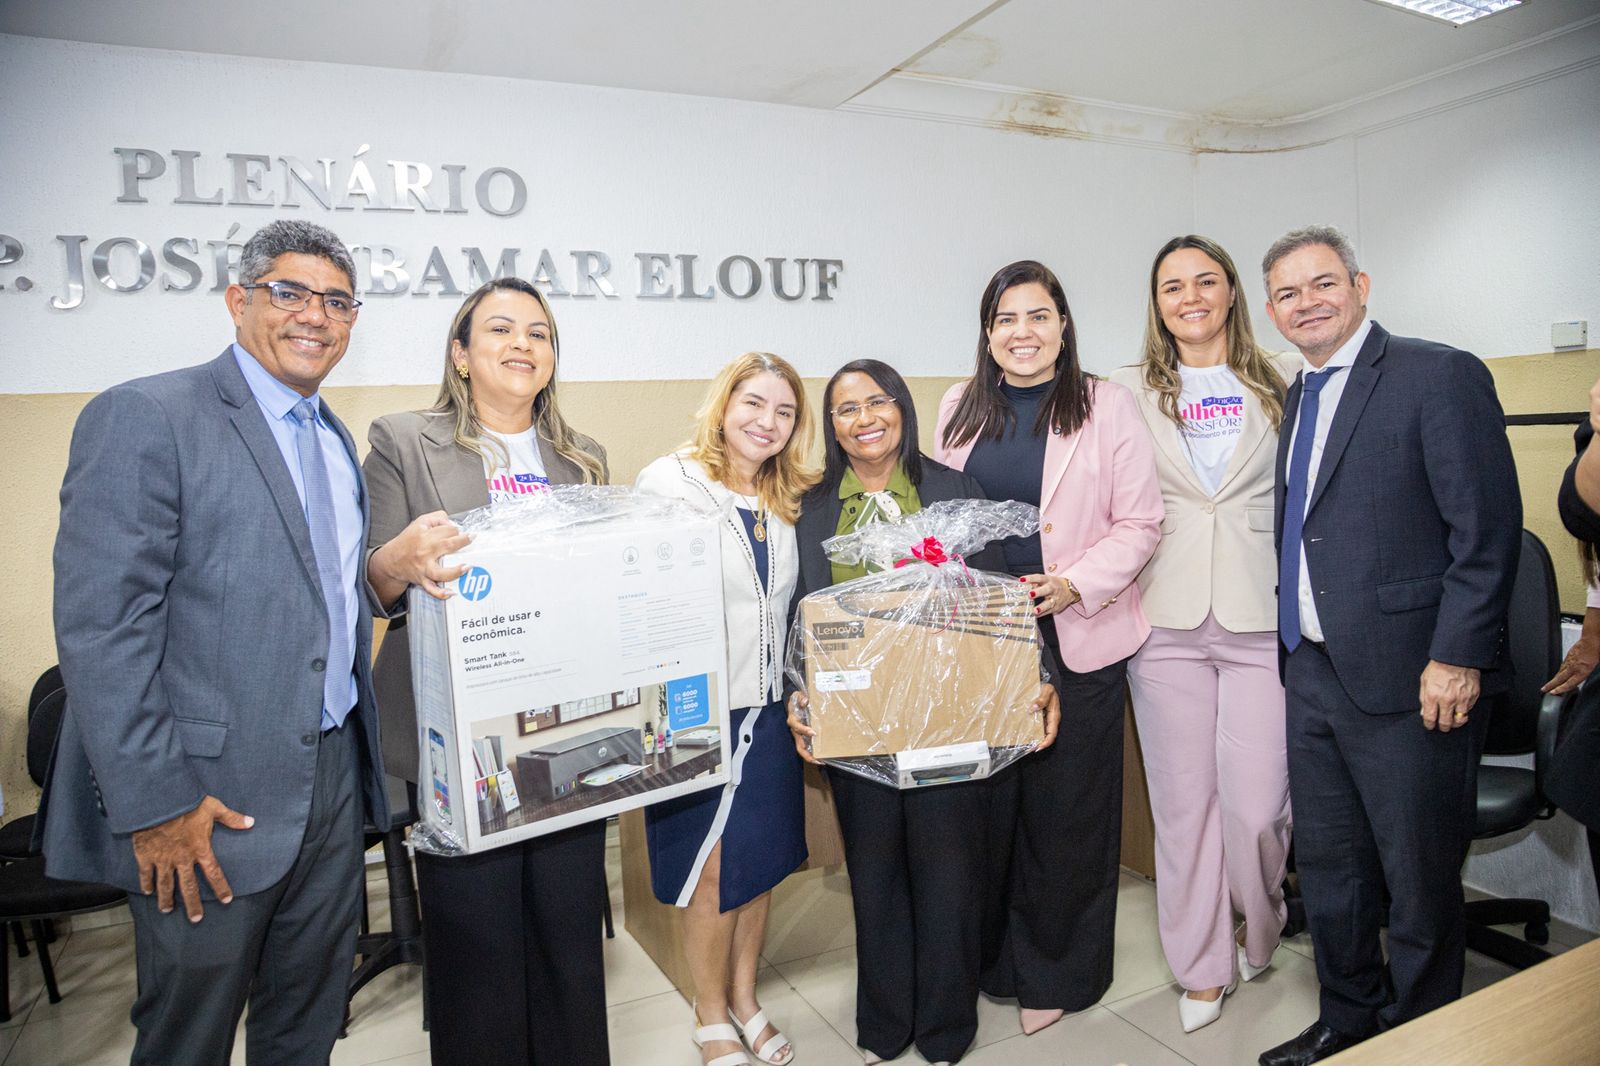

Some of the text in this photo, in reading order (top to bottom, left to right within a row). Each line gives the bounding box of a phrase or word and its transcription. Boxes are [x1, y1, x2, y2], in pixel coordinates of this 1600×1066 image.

[113, 144, 528, 216] PLENÁRIO
[50, 222, 245, 309] JOSÉ
[634, 252, 843, 301] ELOUF
[462, 567, 489, 601] hp
[461, 610, 541, 629] Fácil de usar e
[462, 626, 526, 643] econômica.
[817, 626, 860, 635] Lenovo
[464, 655, 487, 665] Smart
[489, 651, 507, 661] Tank
[465, 657, 525, 672] Wireless All-in-One
